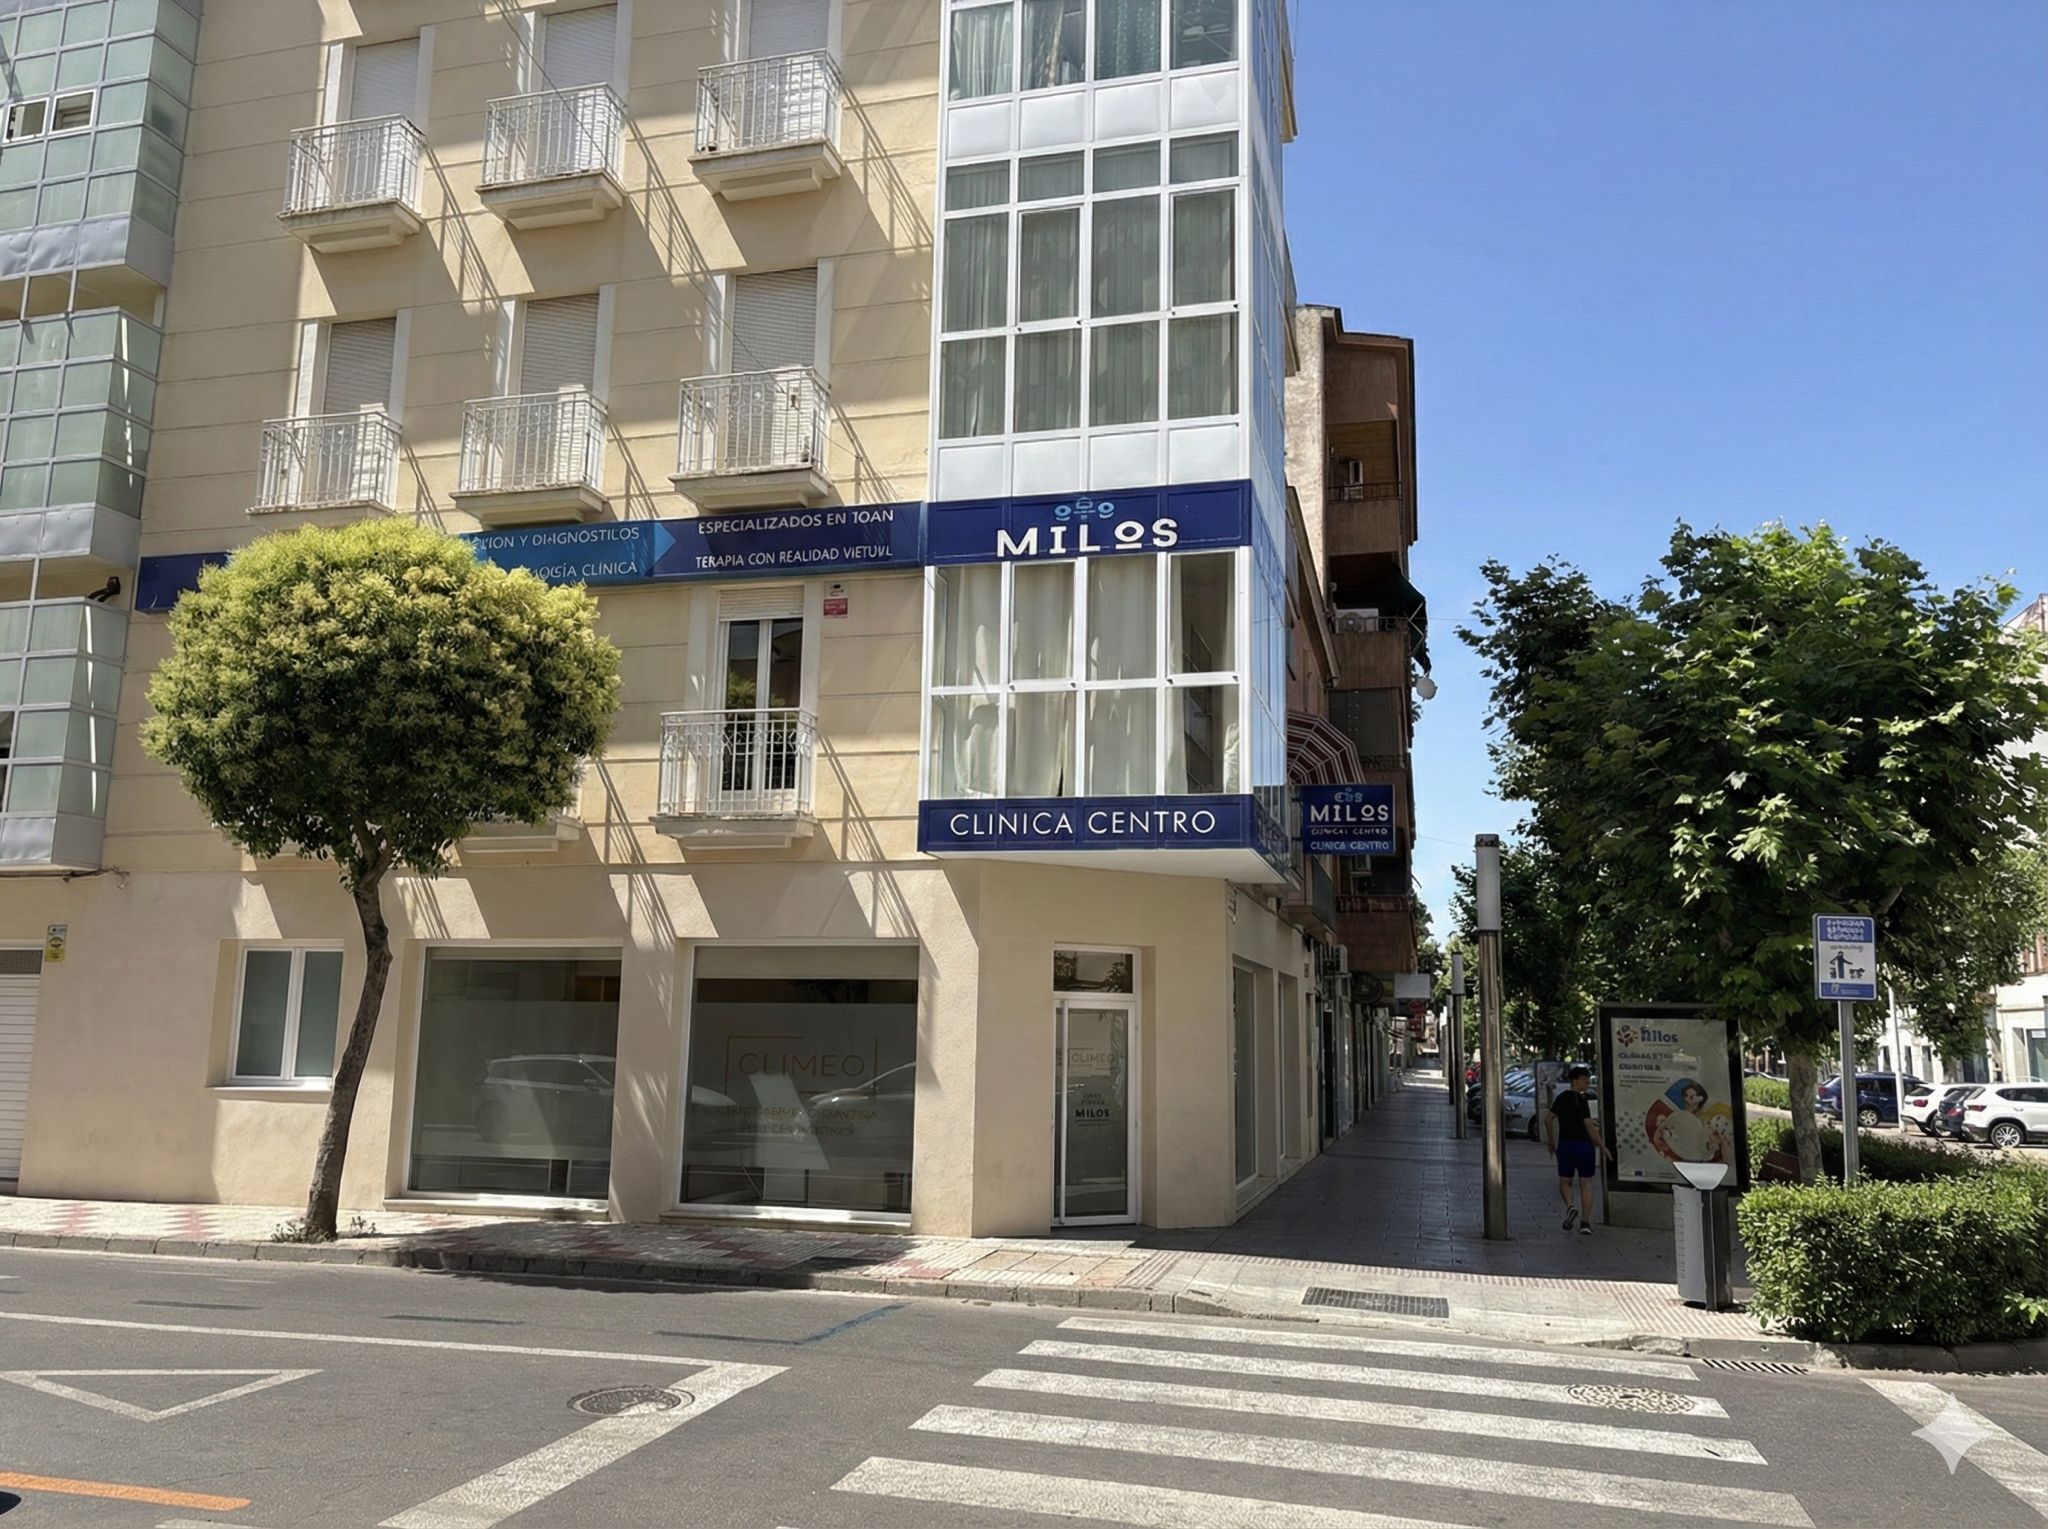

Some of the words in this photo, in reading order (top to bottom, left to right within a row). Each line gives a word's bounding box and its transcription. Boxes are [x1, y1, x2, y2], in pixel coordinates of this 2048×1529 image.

[699, 514, 822, 534] ESPECIALIZADOS
[827, 513, 847, 526] EN
[520, 535, 528, 547] Y
[997, 518, 1178, 557] MILOS
[696, 555, 744, 569] TERAPIA
[748, 552, 775, 565] CON
[779, 548, 839, 564] REALIDAD
[950, 812, 1074, 835] CLINICA
[1088, 810, 1216, 834] CENTRO
[1310, 804, 1389, 822] MILOS
[1350, 841, 1389, 850] CENTRO
[738, 1052, 865, 1077] CLIMEO
